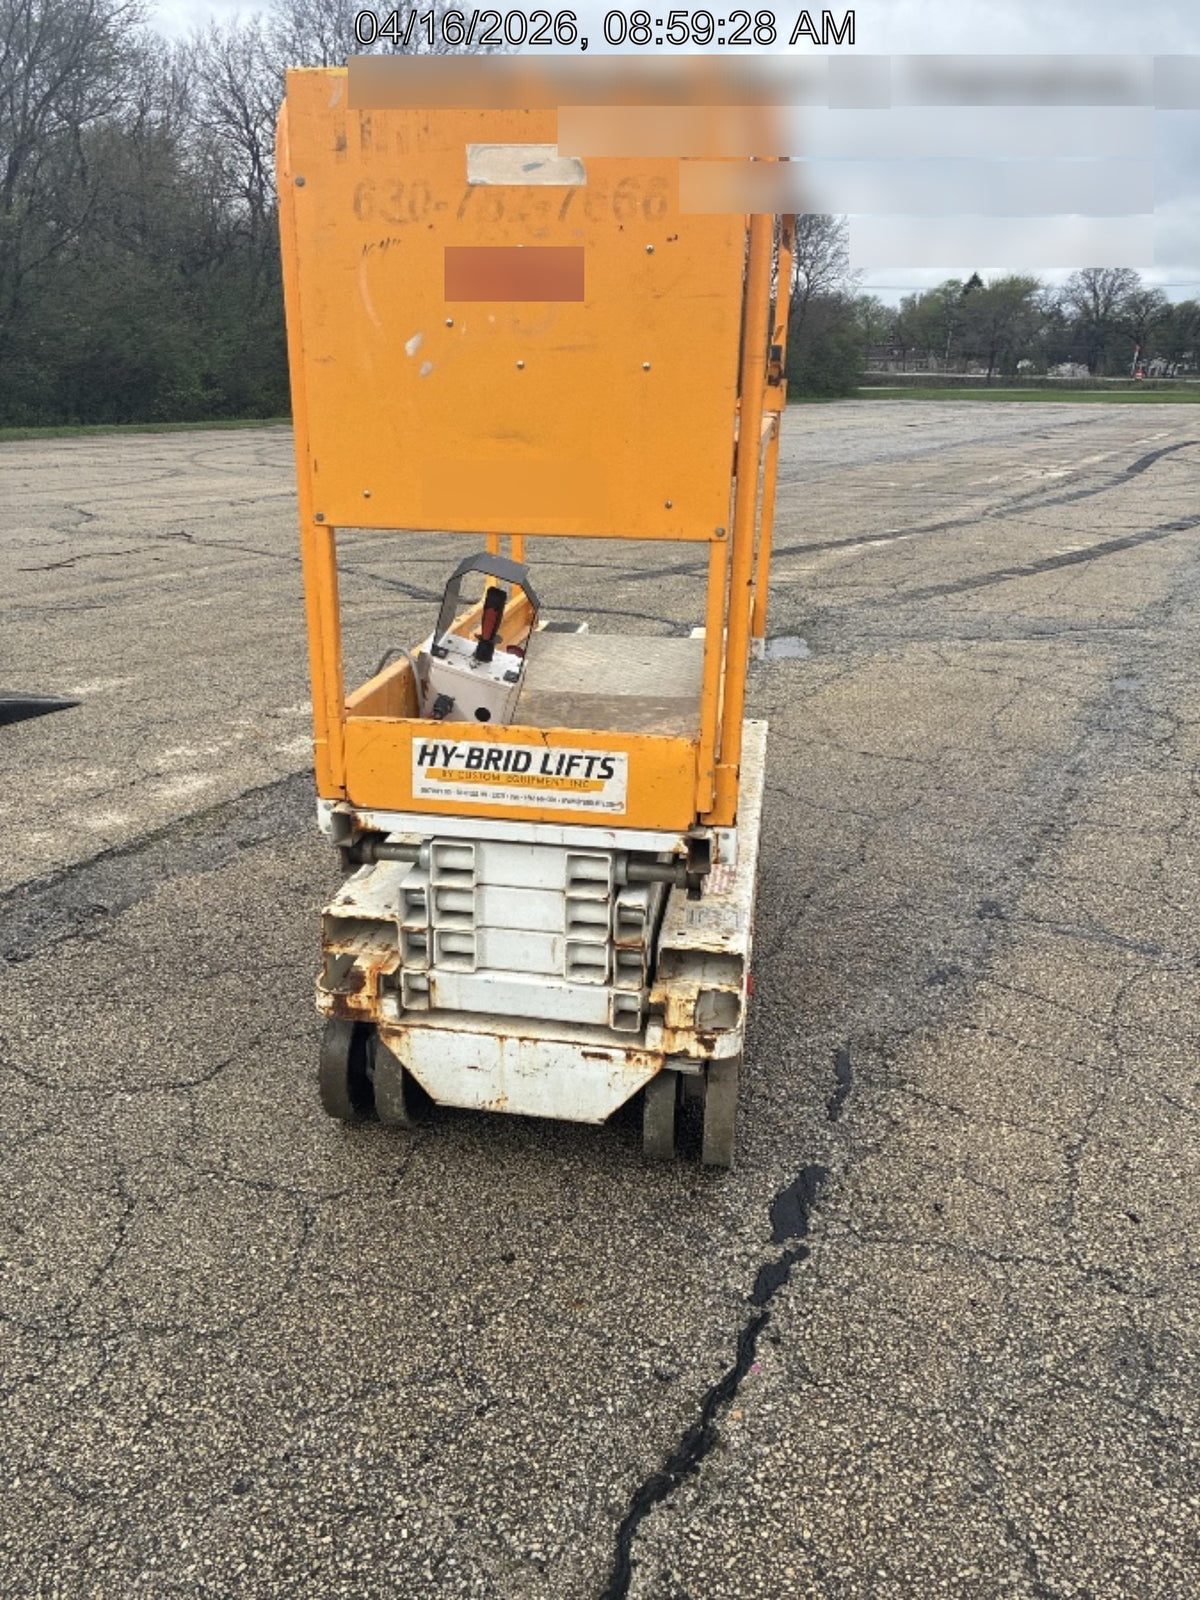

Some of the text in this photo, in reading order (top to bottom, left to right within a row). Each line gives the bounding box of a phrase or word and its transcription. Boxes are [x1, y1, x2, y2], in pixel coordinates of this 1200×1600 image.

[417, 744, 615, 779] HY-BRID LIFTS
[442, 769, 453, 778] BY
[458, 771, 501, 781] CUSTOM
[507, 774, 565, 787] EQUIPMENT
